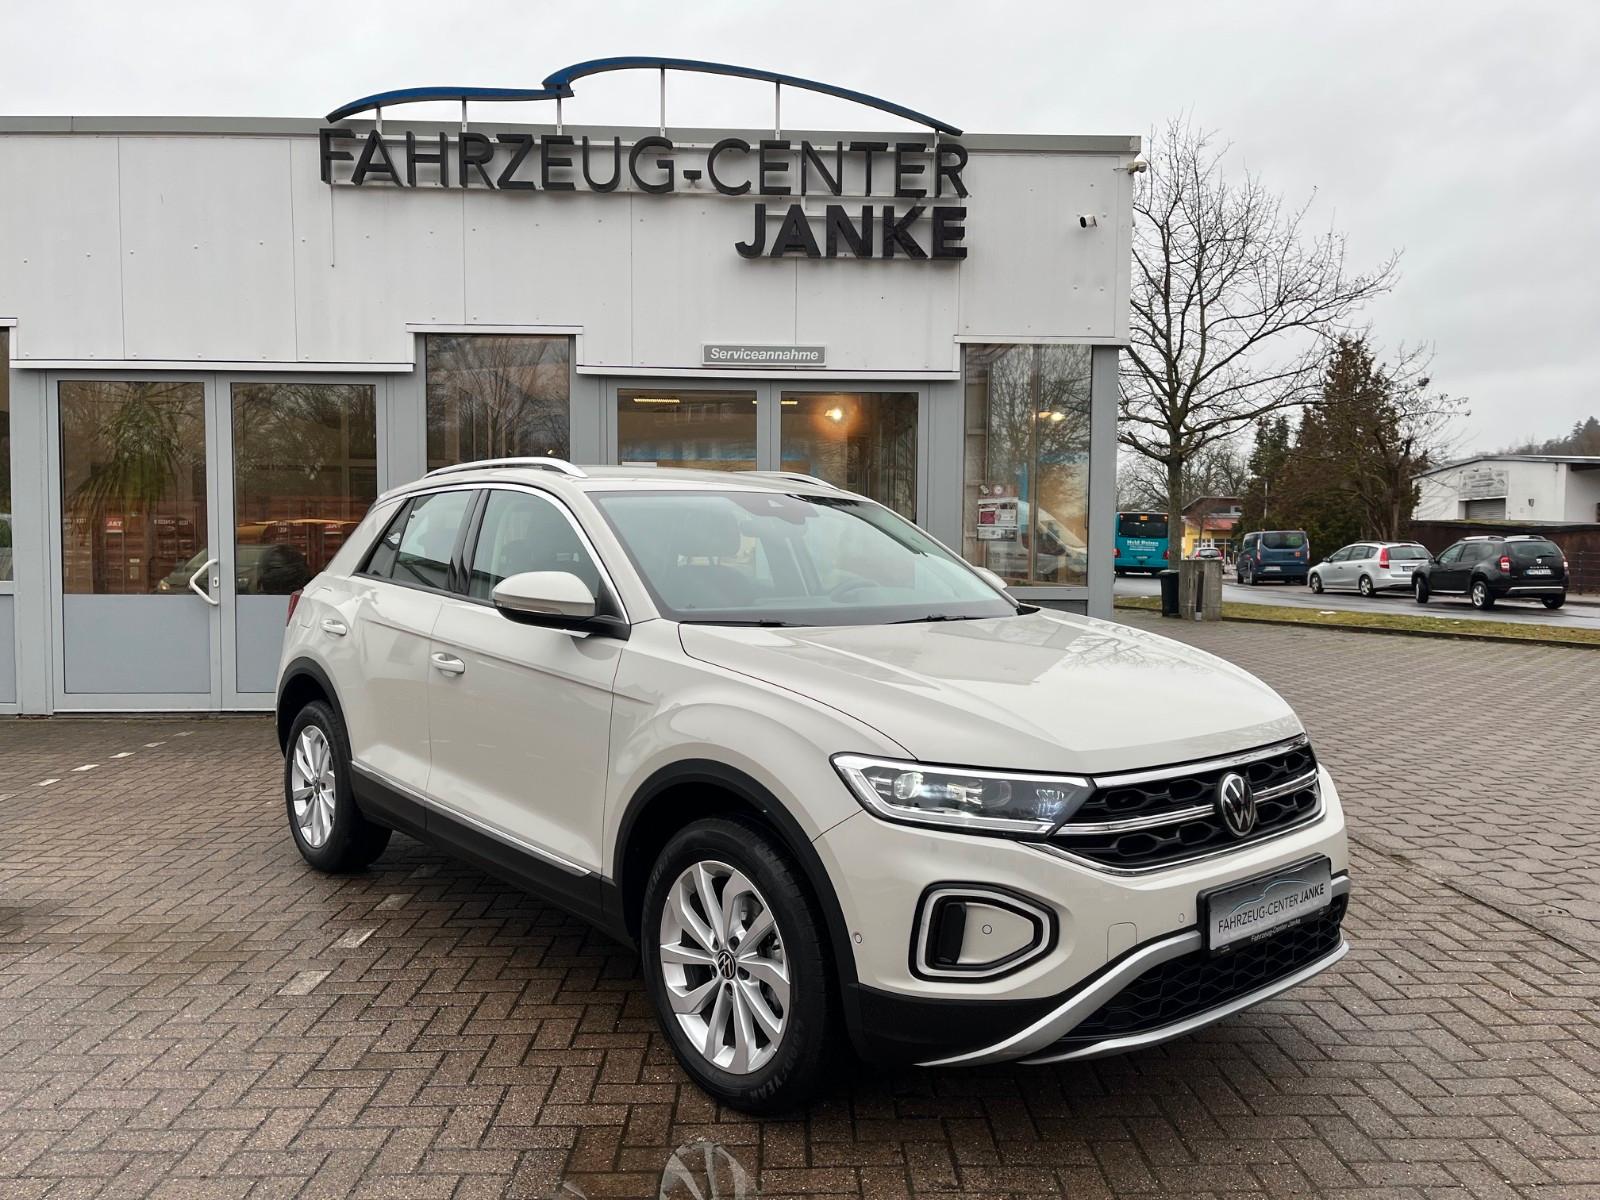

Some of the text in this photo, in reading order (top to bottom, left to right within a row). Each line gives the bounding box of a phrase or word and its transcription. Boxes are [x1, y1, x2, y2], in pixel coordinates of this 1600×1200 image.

[319, 128, 969, 198] FAHRZEUG-CENTER
[735, 203, 968, 260] JANKE
[710, 347, 819, 360] Serviceannahme
[1218, 882, 1325, 933] FAHRZEUG-CENTER JANKE
